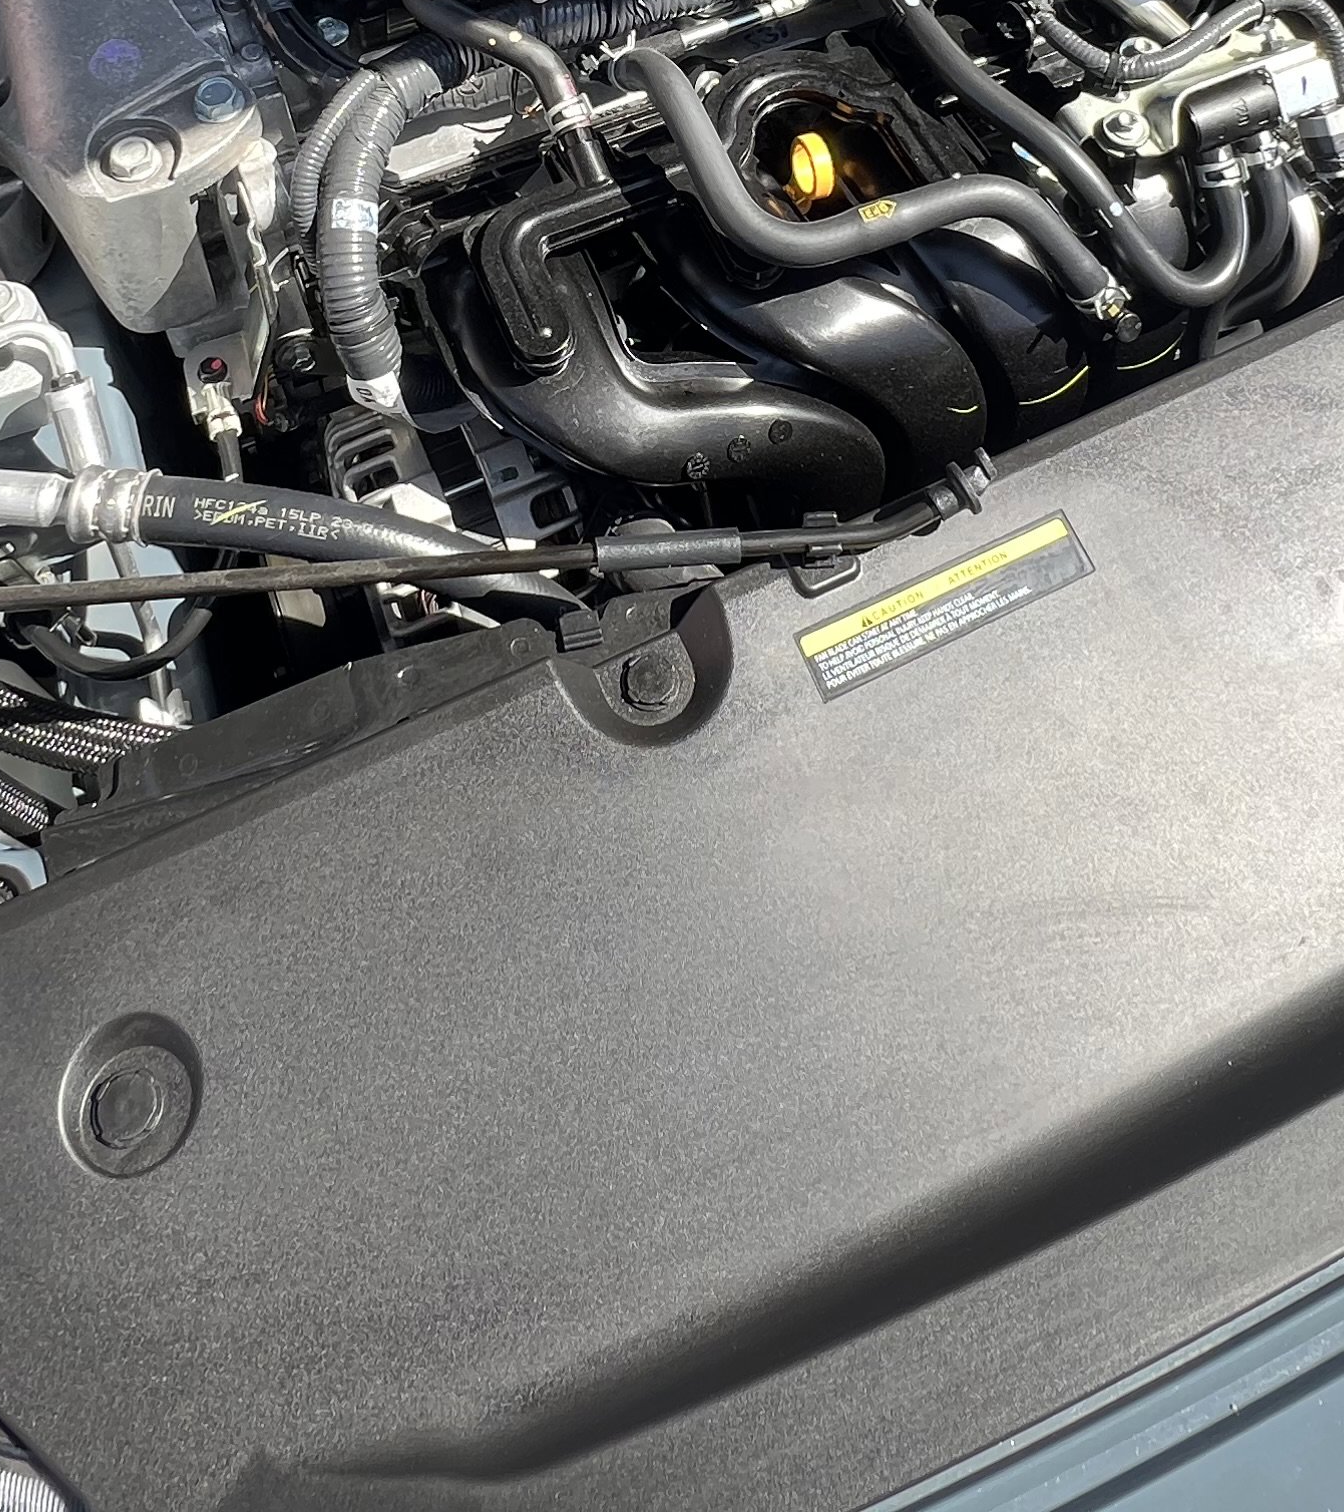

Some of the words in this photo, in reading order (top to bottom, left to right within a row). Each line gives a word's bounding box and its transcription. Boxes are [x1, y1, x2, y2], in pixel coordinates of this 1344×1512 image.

[142, 494, 176, 519] RIN
[281, 507, 322, 523] 15LP
[948, 550, 1009, 586] ATTENTION
[871, 591, 925, 621] CAUTION
